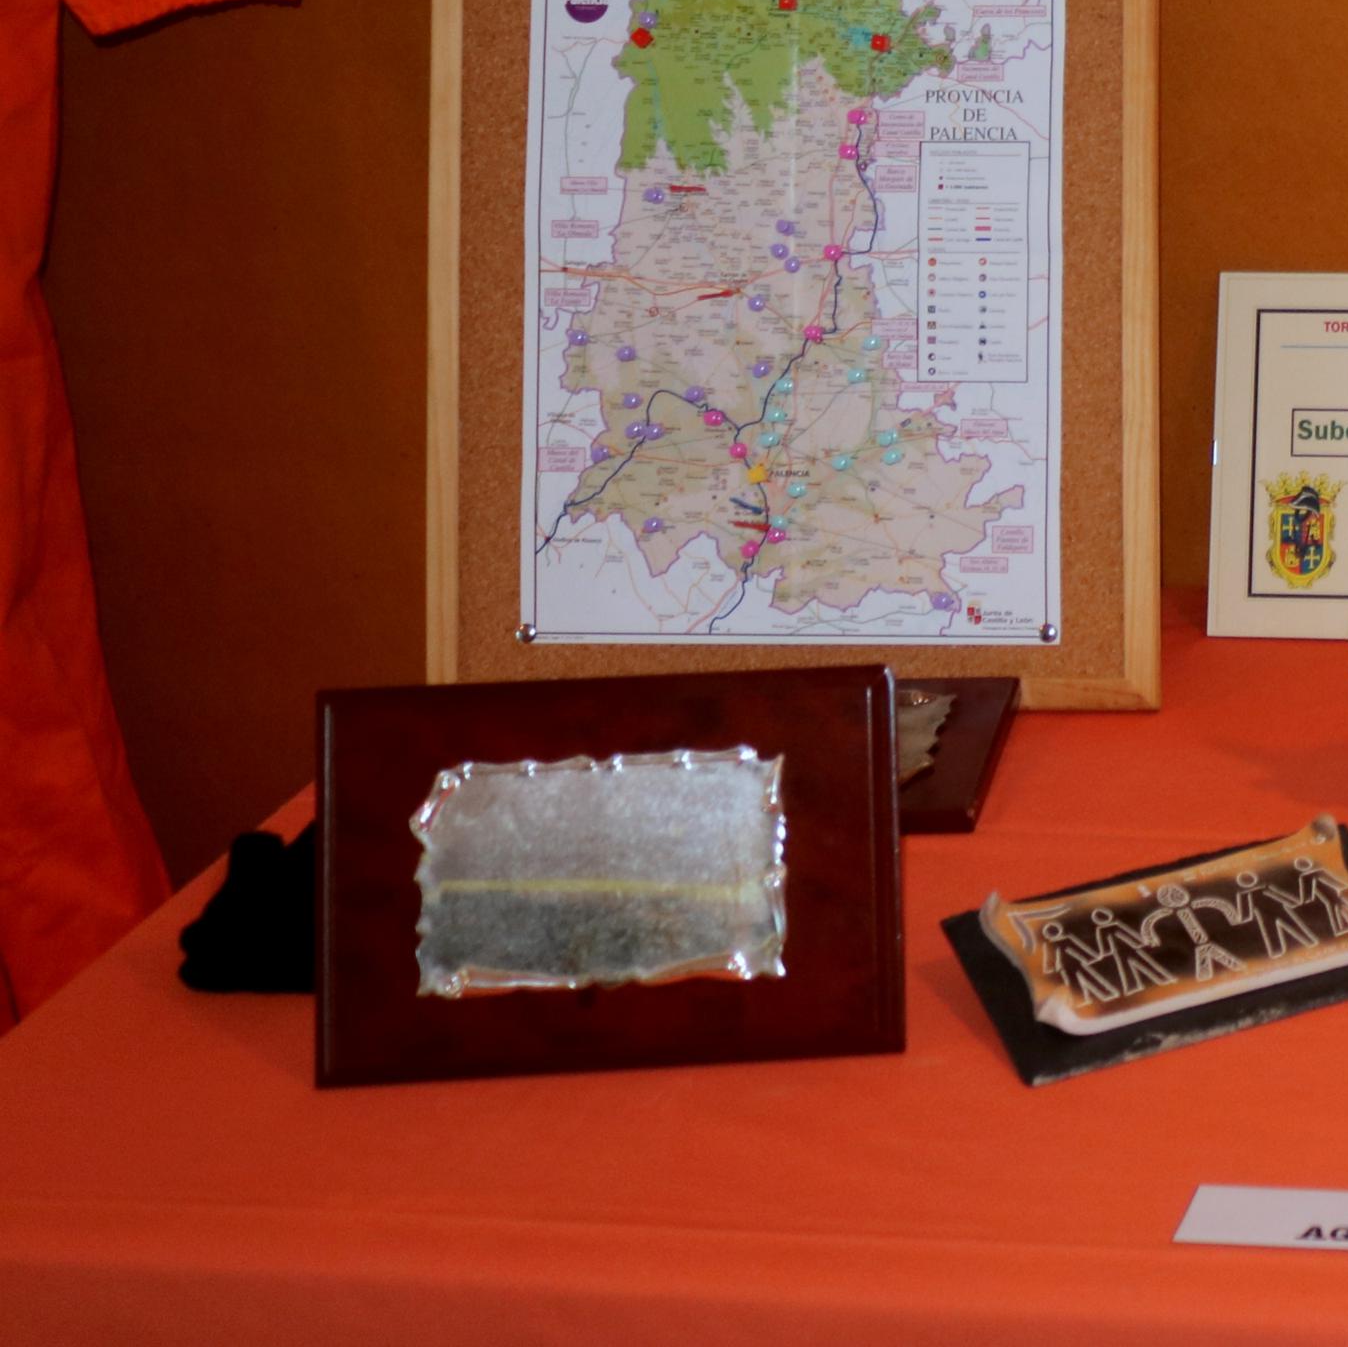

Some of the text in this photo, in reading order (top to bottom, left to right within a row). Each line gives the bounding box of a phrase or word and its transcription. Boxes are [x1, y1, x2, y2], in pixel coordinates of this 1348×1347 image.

[925, 89, 1024, 103] PROVINCIA
[963, 108, 987, 122] DE
[930, 126, 1018, 140] PALENCIA
